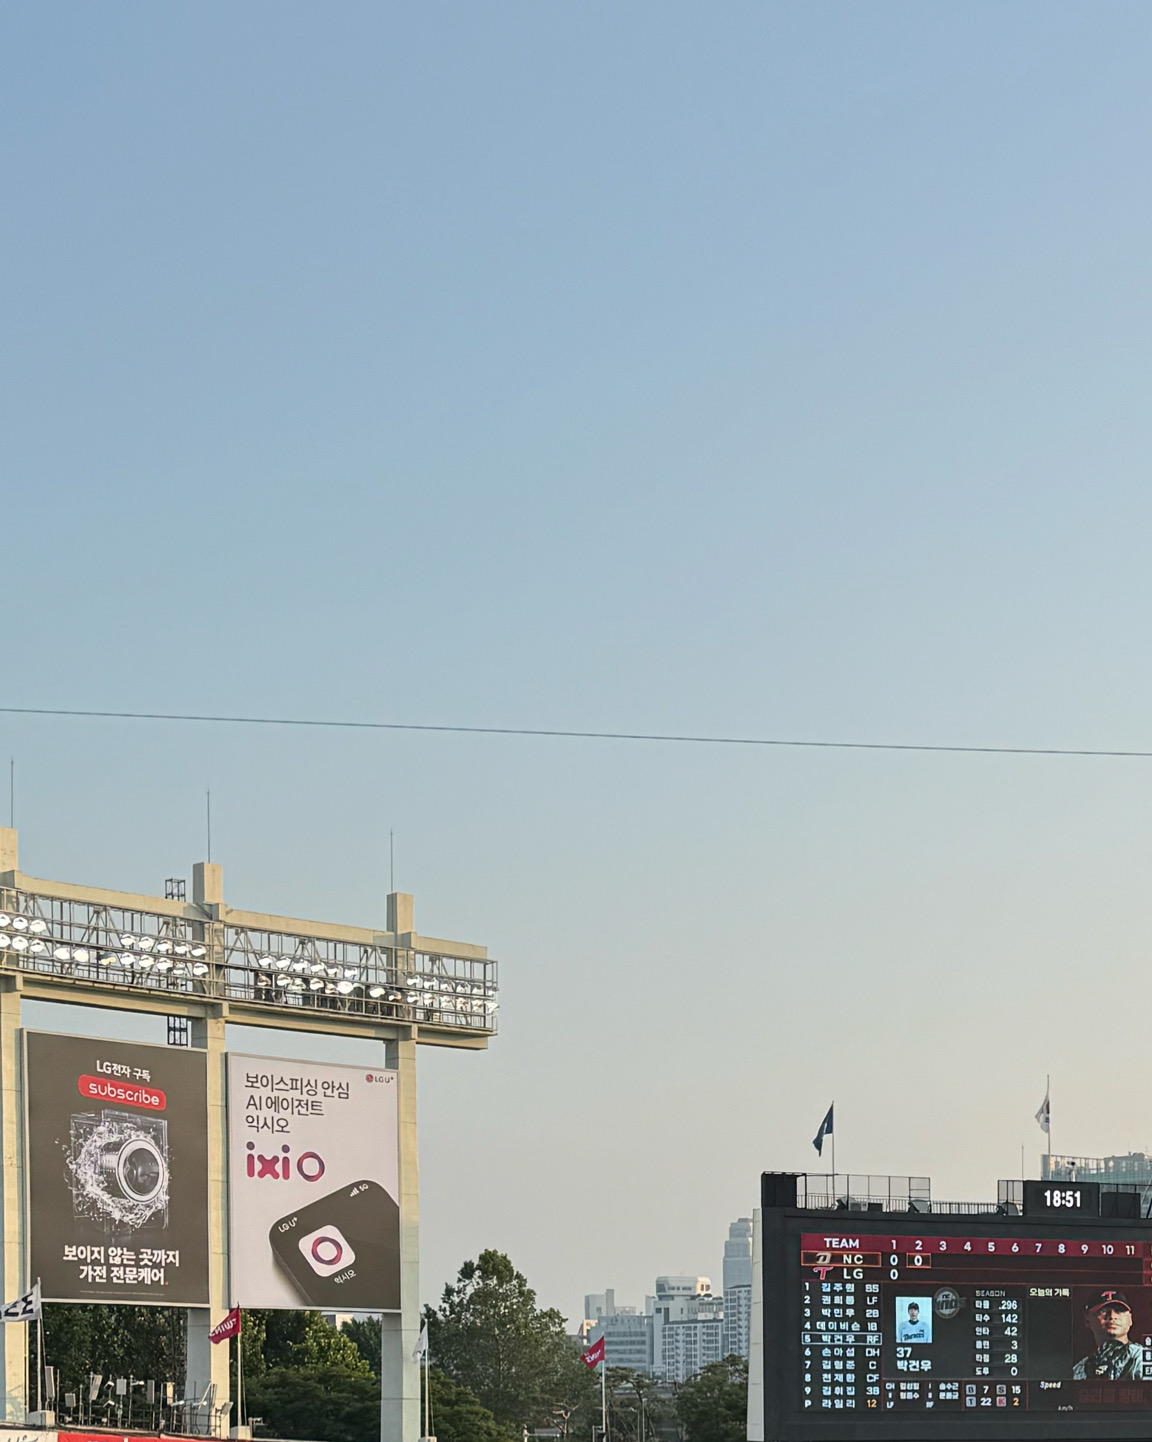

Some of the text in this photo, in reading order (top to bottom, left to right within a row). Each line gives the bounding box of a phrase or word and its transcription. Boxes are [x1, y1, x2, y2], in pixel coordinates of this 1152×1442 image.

[96, 1060, 151, 1082] LG전자 구독
[245, 1073, 350, 1099] 보이스피싱 안심
[88, 1083, 160, 1105] subscribe
[246, 1095, 324, 1116] AI 에이전트
[245, 1115, 290, 1134] 익시오
[1043, 1190, 1082, 1208] 18:51
[823, 1238, 860, 1248] TEAM
[891, 1240, 897, 1250] 1
[915, 1240, 923, 1250] 2
[939, 1241, 947, 1251] 3
[963, 1242, 971, 1251] 4
[988, 1242, 995, 1252] 5
[1011, 1243, 1019, 1252] 6
[1035, 1243, 1042, 1253] 7
[1058, 1244, 1065, 1253] 8
[1081, 1244, 1088, 1254] 9
[1102, 1245, 1114, 1255] 10
[1125, 1245, 1135, 1255] 11
[63, 1245, 180, 1267] 보이지 않는 곳까지
[843, 1254, 864, 1264] NC
[890, 1255, 898, 1266] 0
[914, 1255, 922, 1266] 0
[79, 1265, 107, 1282] 가전
[843, 1268, 863, 1279] LG
[890, 1269, 898, 1280] 0
[1001, 1314, 1018, 1323] 142
[804, 1321, 811, 1330] 4
[867, 1322, 878, 1331] 1B
[1004, 1327, 1018, 1336] 42
[1011, 1341, 1018, 1350] 3
[865, 1348, 879, 1357] DH
[896, 1347, 912, 1358] 37
[1004, 1354, 1018, 1363] 28
[896, 1360, 932, 1372] 박건우
[1011, 1367, 1018, 1376] 0
[983, 1385, 1021, 1394] 7 15
[1040, 1381, 1061, 1390] Speed
[804, 1400, 811, 1408] P
[867, 1399, 877, 1408] 12
[980, 1398, 1019, 1406] 22 2
